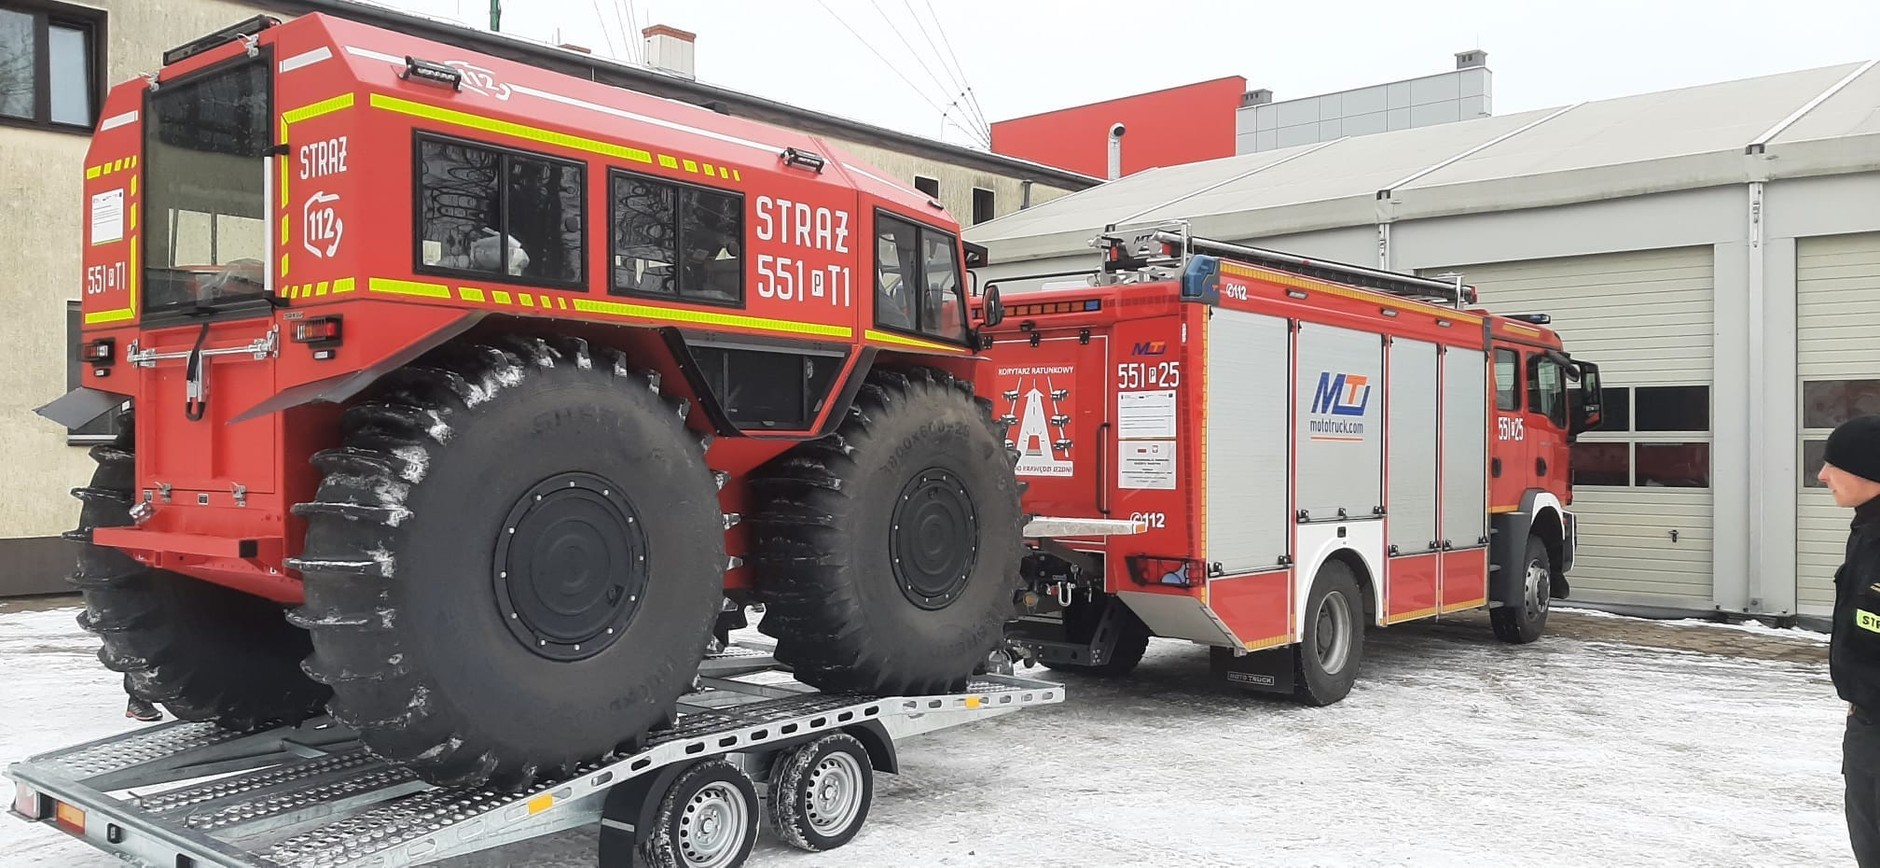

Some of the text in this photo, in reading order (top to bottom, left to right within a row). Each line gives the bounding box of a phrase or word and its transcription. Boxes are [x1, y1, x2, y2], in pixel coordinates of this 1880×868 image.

[309, 207, 335, 241] 112
[88, 264, 106, 294] 551
[757, 254, 804, 302] 551
[828, 264, 850, 307] T1
[1031, 366, 1074, 375] RATUNKOWY
[1118, 363, 1145, 389] 551
[1158, 362, 1180, 388] 25
[1309, 418, 1364, 434] mototruck.com
[1498, 416, 1511, 441] 551
[1514, 417, 1524, 441] 25
[1142, 512, 1165, 528] 112
